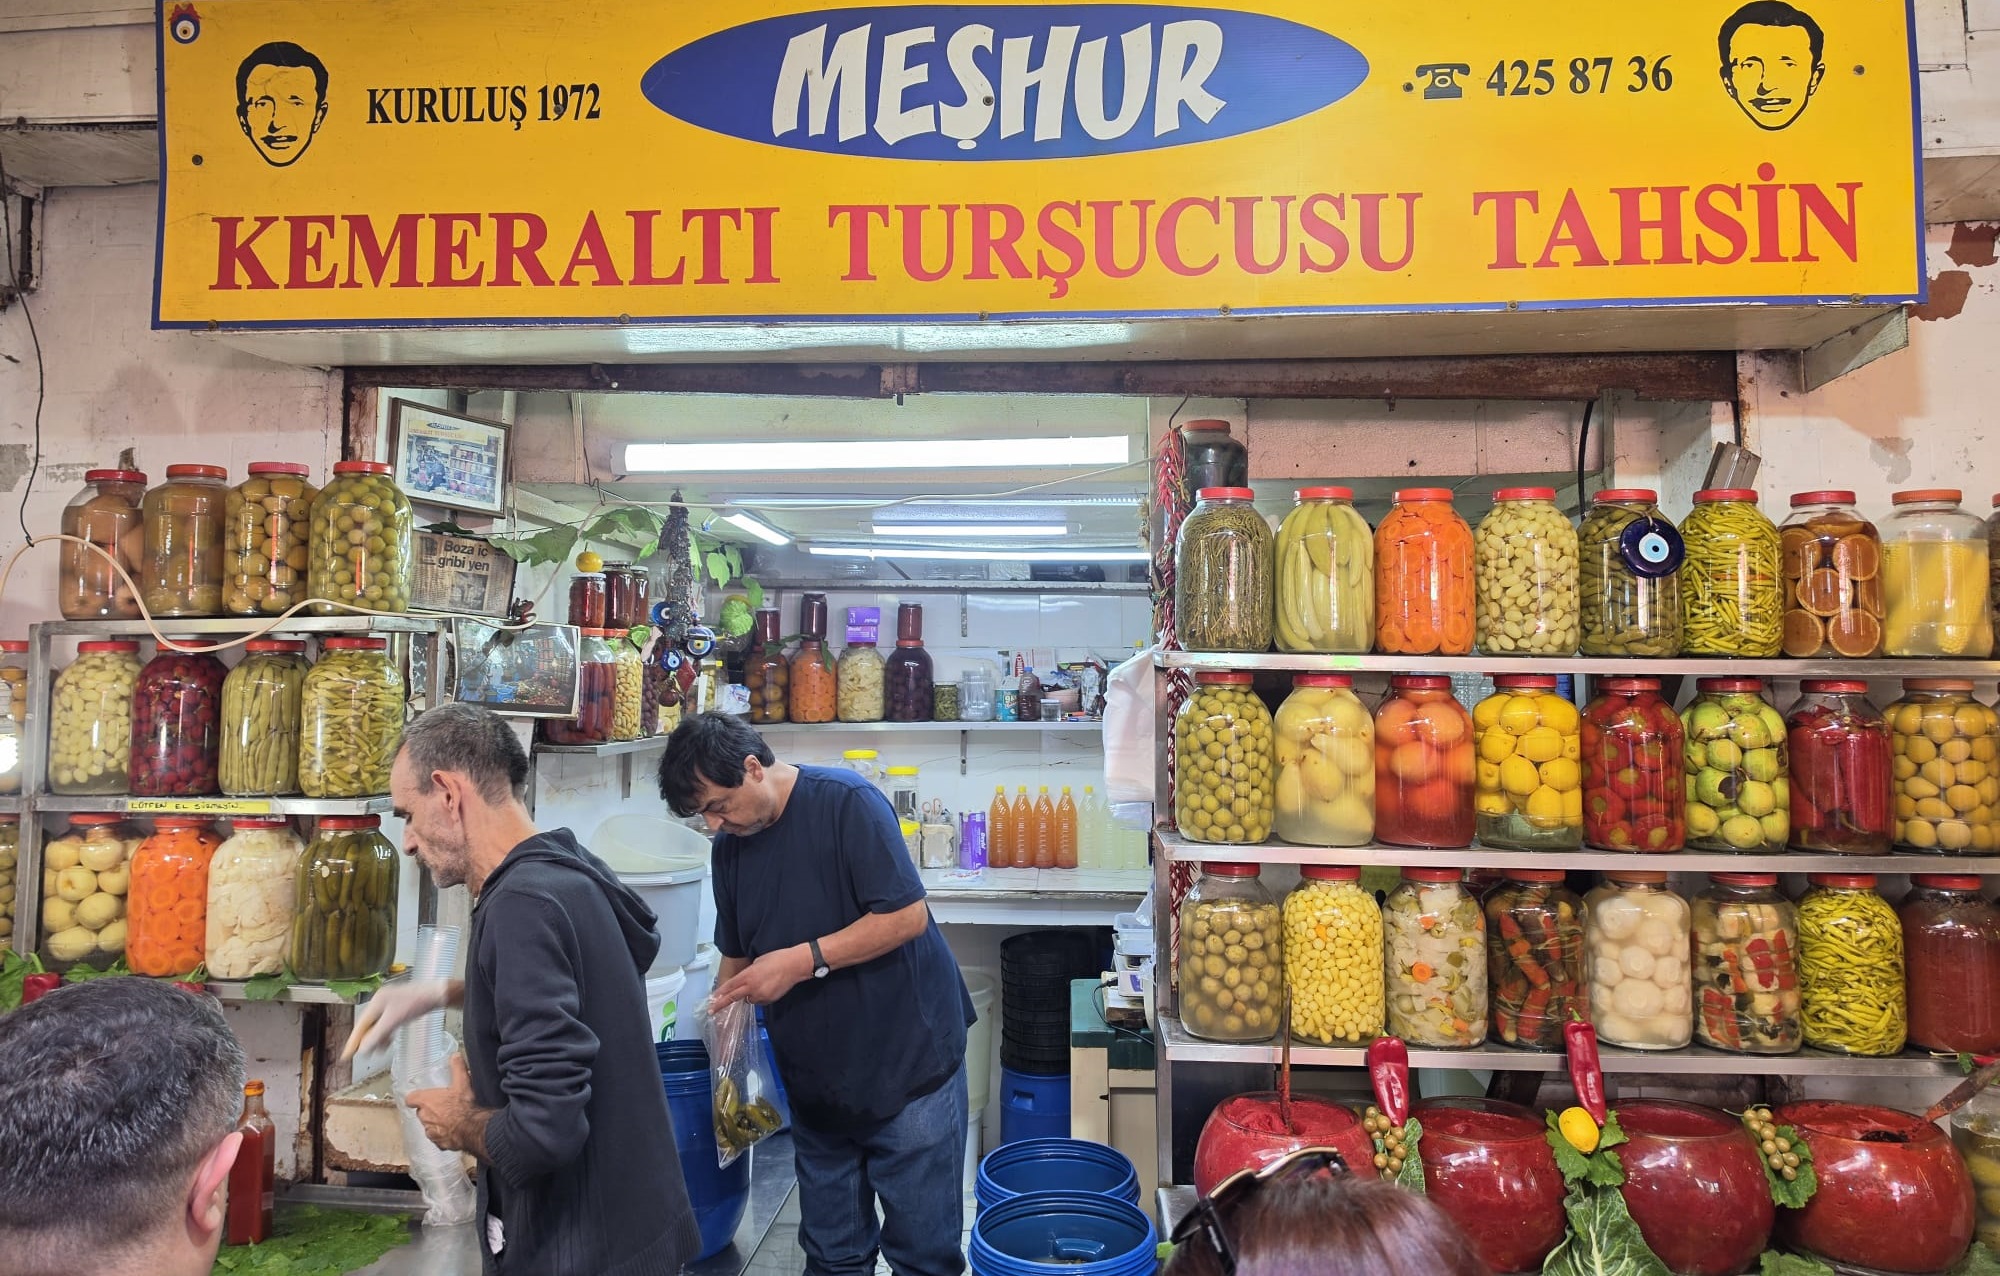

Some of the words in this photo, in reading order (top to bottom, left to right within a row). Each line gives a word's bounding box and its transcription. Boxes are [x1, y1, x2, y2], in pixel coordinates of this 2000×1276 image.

[772, 20, 1227, 149] MEŞHUR
[1486, 59, 1555, 96] 425
[1569, 57, 1613, 94] 87
[1627, 55, 1673, 92] 36
[366, 85, 527, 131] KURULUŞ
[537, 83, 601, 121] 1972
[208, 207, 781, 291] KEMERALTI
[828, 192, 1423, 299] TURŞUCUSU
[1473, 162, 1863, 270] TAHSİN
[437, 556, 466, 569] gribi
[468, 560, 490, 572] yen
[443, 540, 474, 556] Boza
